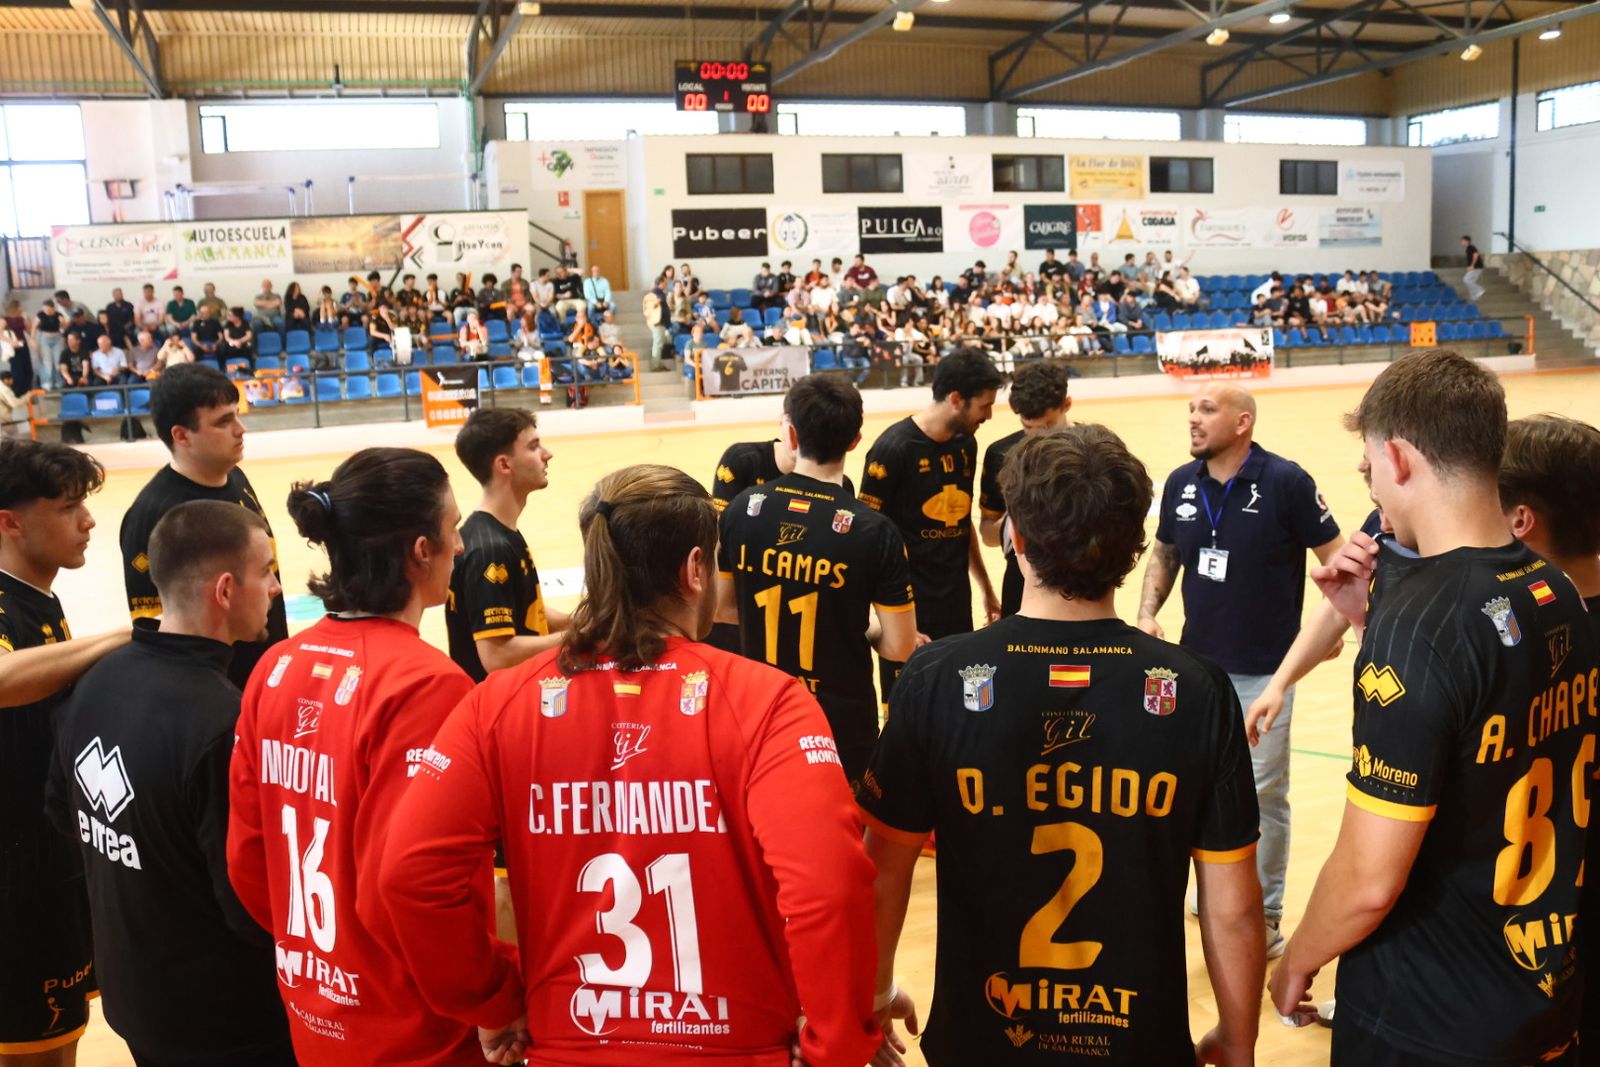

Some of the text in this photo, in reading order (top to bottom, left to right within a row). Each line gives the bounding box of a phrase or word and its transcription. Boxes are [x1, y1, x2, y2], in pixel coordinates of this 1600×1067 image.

[700, 62, 749, 80] 00:00
[678, 82, 705, 92] LOCAL
[684, 93, 707, 110] 00
[746, 94, 769, 112] 00
[1141, 217, 1176, 226] CODASA
[188, 226, 287, 242] AUTOESCUELA
[672, 226, 767, 240] Pubeer
[185, 244, 286, 262] SALAMANCA
[724, 361, 734, 376] 6
[753, 368, 789, 377] ETERNO
[940, 454, 955, 473] 10
[737, 544, 848, 589] J. CAMPS
[753, 584, 819, 672] 11
[1007, 644, 1133, 655] BALONMANO SALAMANCA
[1372, 757, 1419, 786] Moreno
[956, 761, 1178, 818] D. EGIDO
[77, 809, 143, 871] errea
[281, 803, 337, 954] 16
[1017, 821, 1104, 970] 2
[573, 852, 704, 995] 31
[651, 1019, 730, 1036] fertilizantes
[1058, 1011, 1129, 1028] fertilizantes
